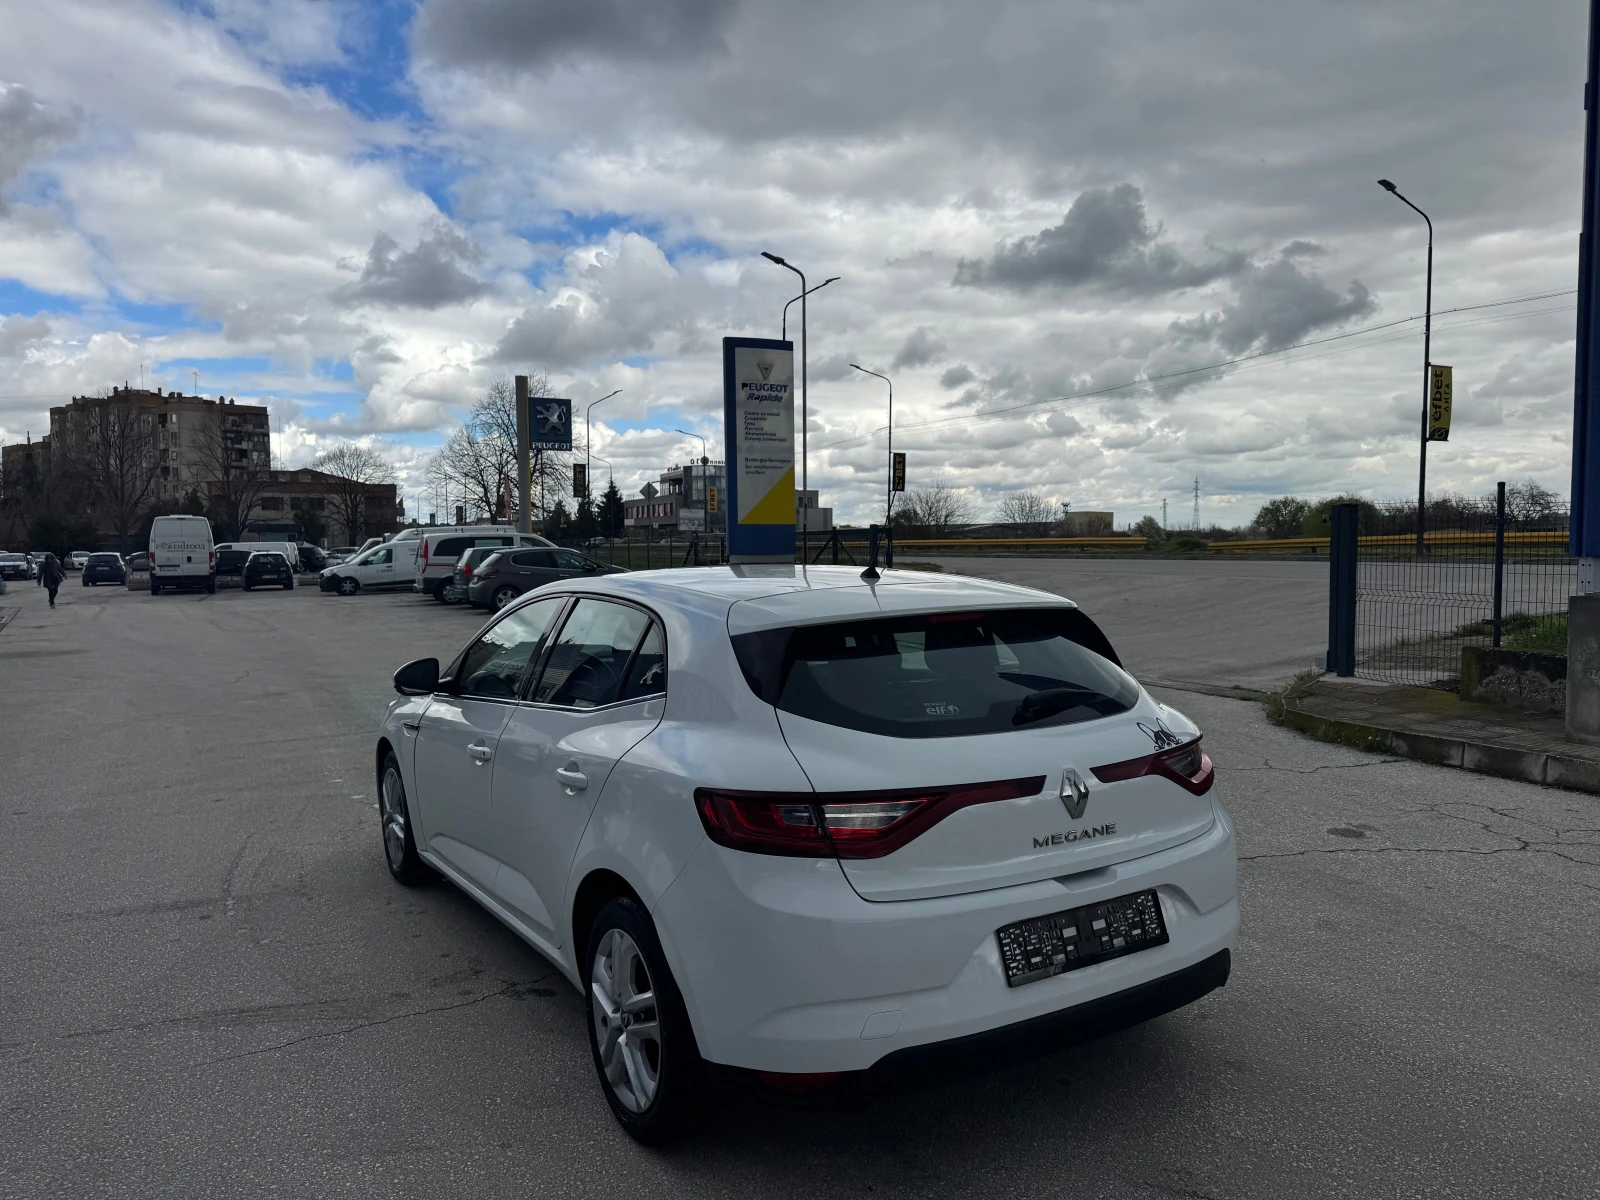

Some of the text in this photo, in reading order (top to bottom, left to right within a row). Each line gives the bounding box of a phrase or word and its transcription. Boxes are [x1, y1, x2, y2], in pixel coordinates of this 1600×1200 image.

[742, 382, 788, 393] PEUGEOT
[746, 392, 784, 402] Rapide
[1432, 370, 1443, 422] efbet
[532, 442, 571, 450] PEUGEOT
[926, 706, 946, 715] elf
[1032, 822, 1117, 848] MEGANE
